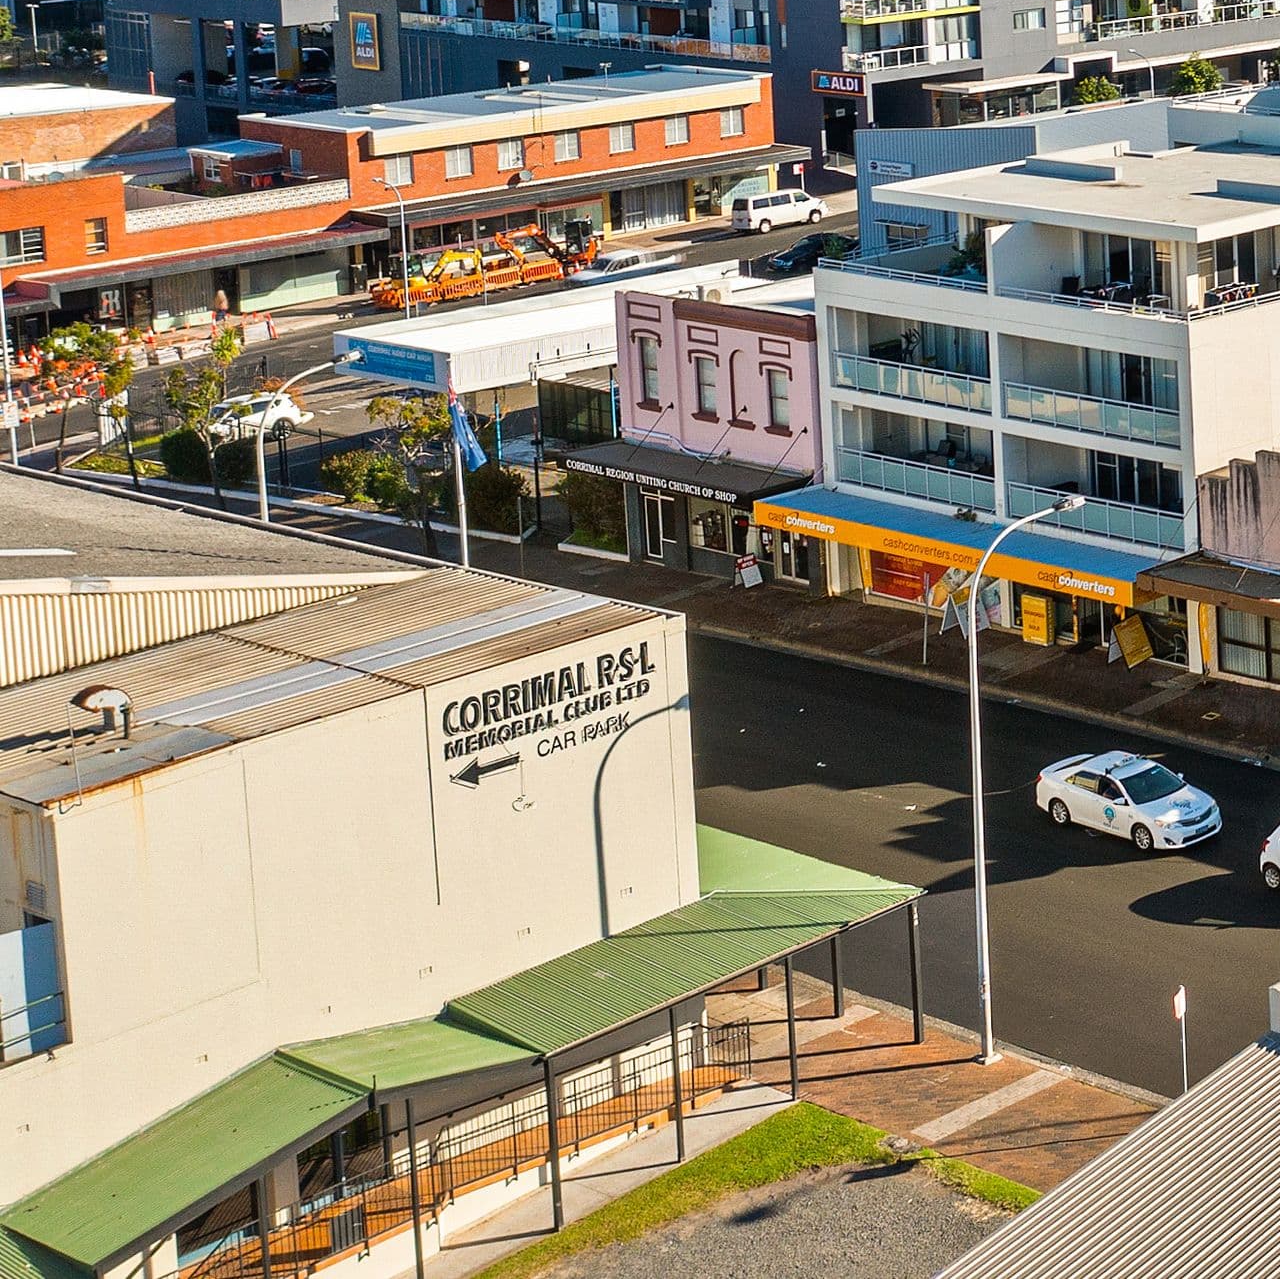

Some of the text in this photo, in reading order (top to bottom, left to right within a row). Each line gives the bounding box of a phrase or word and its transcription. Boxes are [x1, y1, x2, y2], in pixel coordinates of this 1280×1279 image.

[356, 46, 374, 58] ALDI
[831, 77, 858, 91] ALDI
[566, 459, 737, 503] CORRIMAL REGION UNITING CHURCH OP SHOP
[786, 516, 835, 534] converters
[1058, 577, 1115, 596] converters
[443, 662, 592, 737] CORRIMAL
[444, 679, 650, 761] MEMORIAL CLUB LTD
[537, 711, 631, 757] CAR PARK
